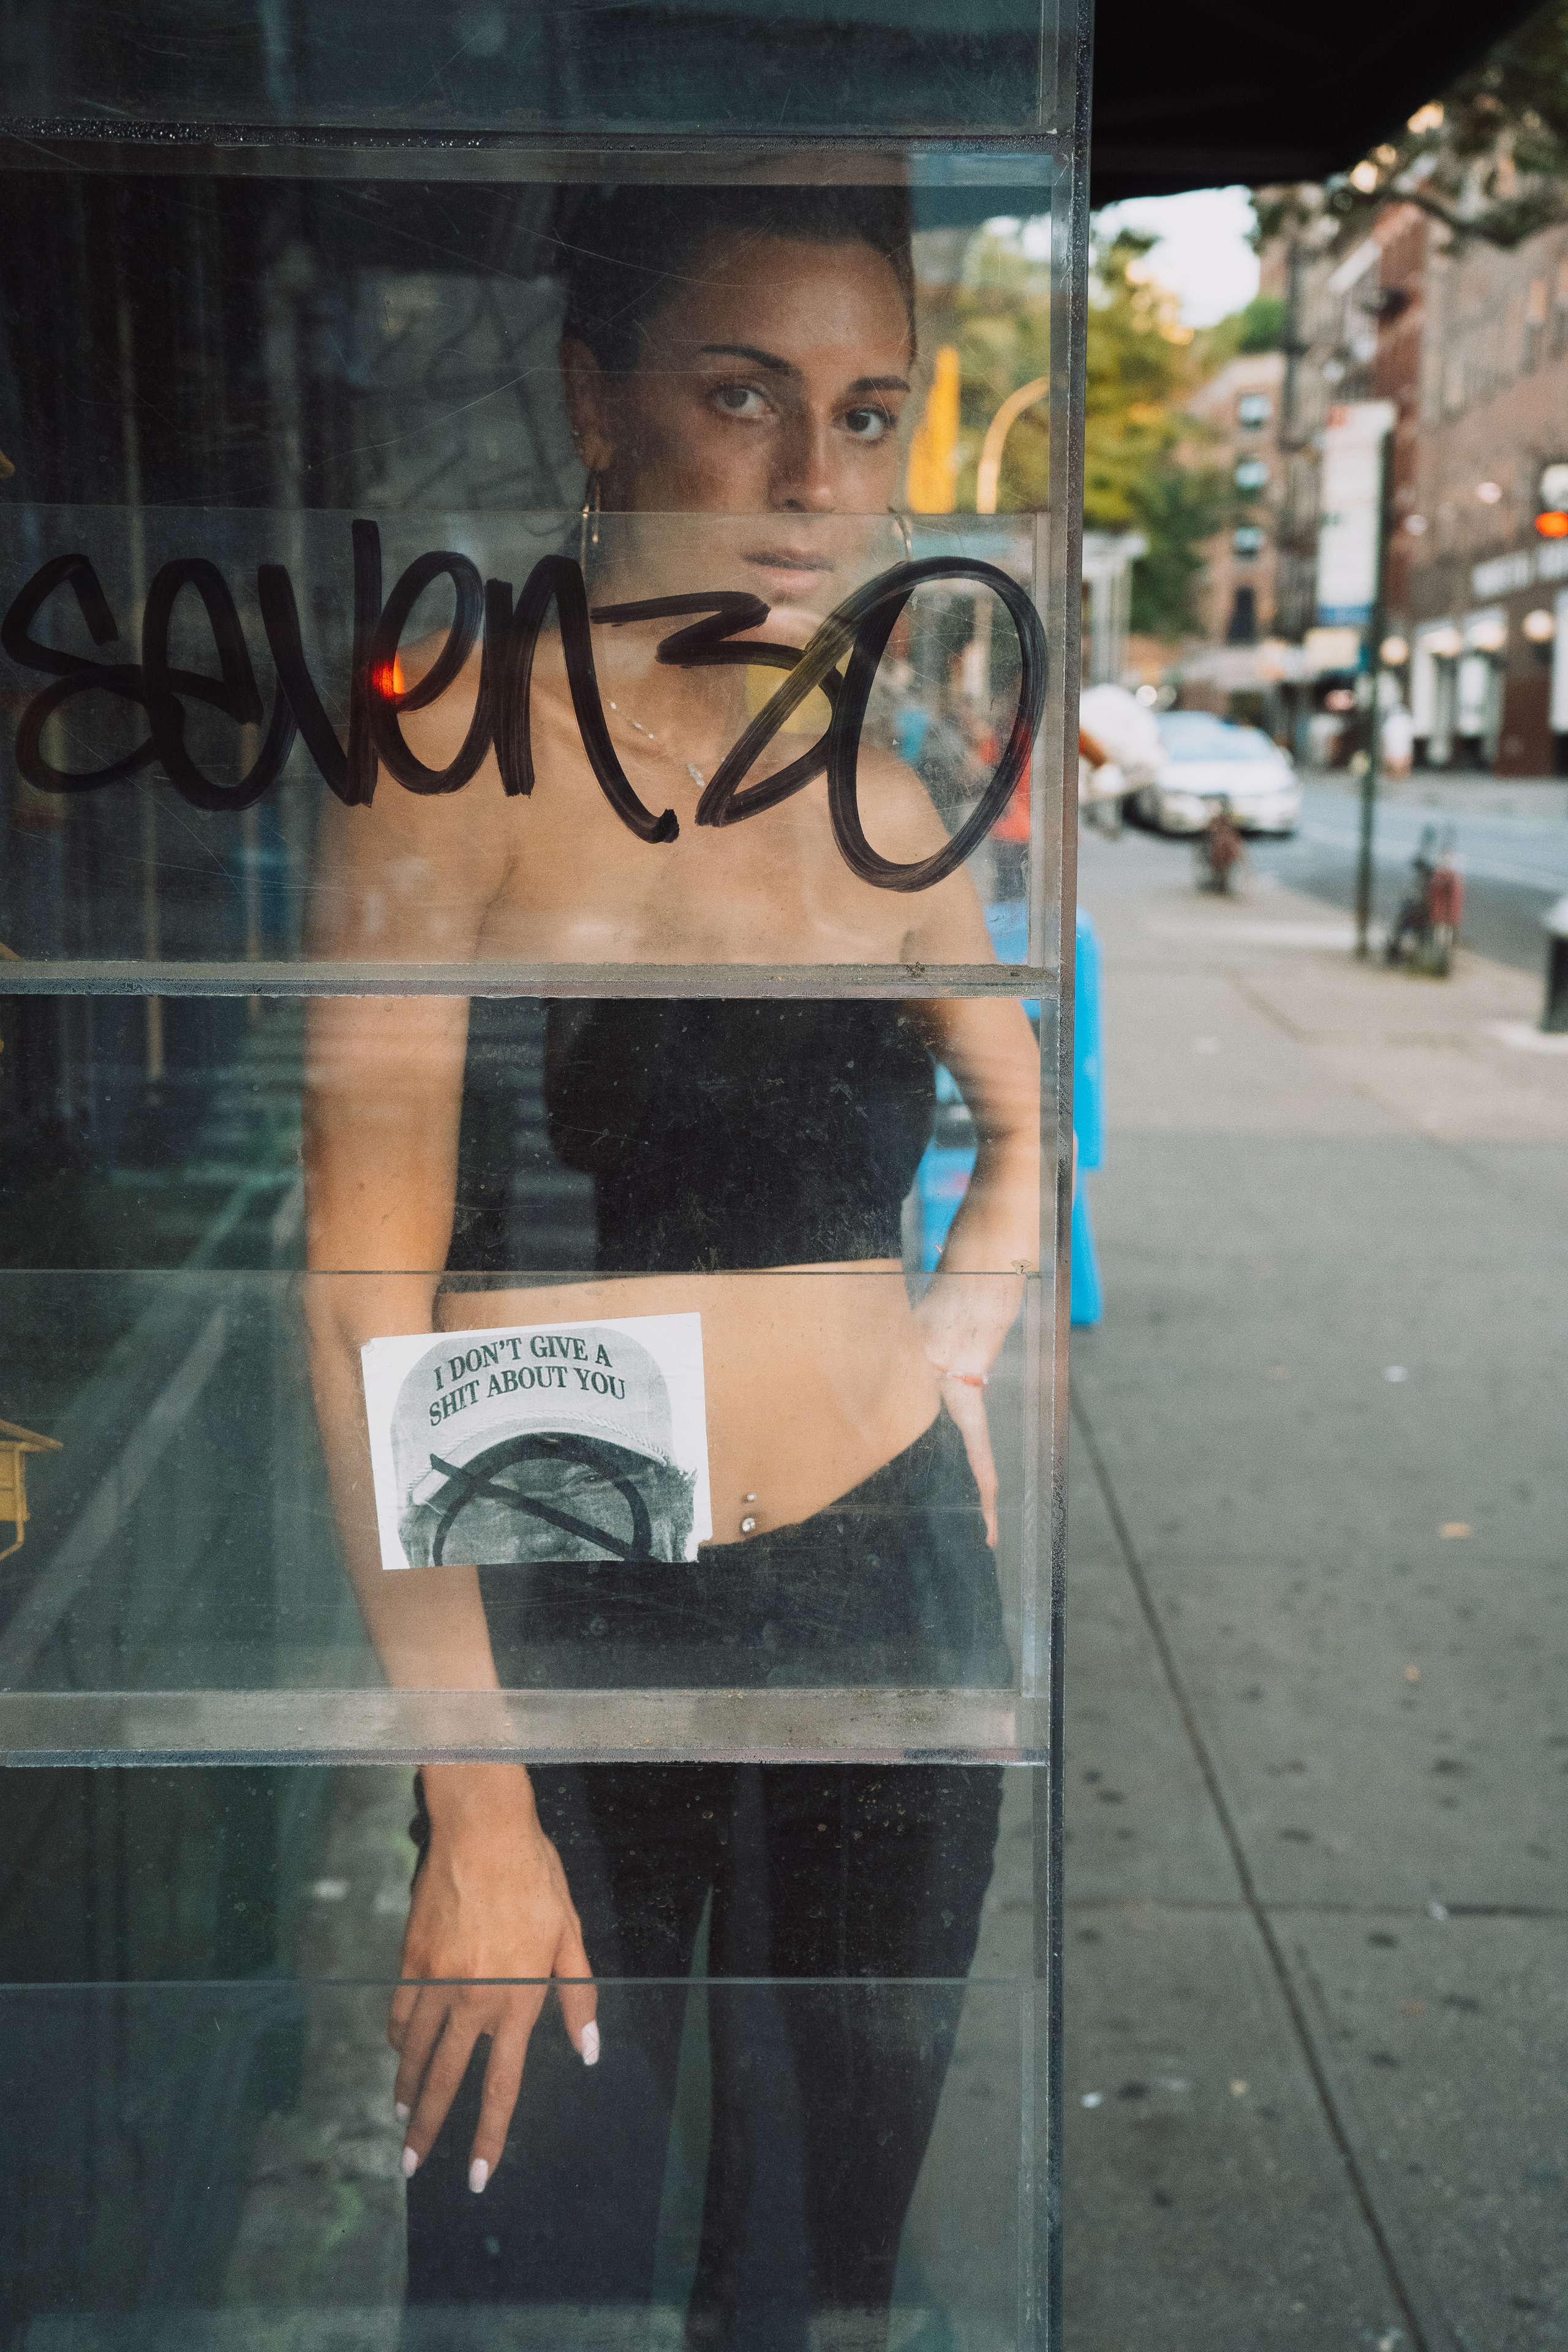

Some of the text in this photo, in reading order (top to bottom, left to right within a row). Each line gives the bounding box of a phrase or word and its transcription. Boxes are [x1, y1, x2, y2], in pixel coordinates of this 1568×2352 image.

[434, 1335, 613, 1392] I DON'T GIVE A
[429, 1365, 626, 1427] SHIT ABOUT YOU
